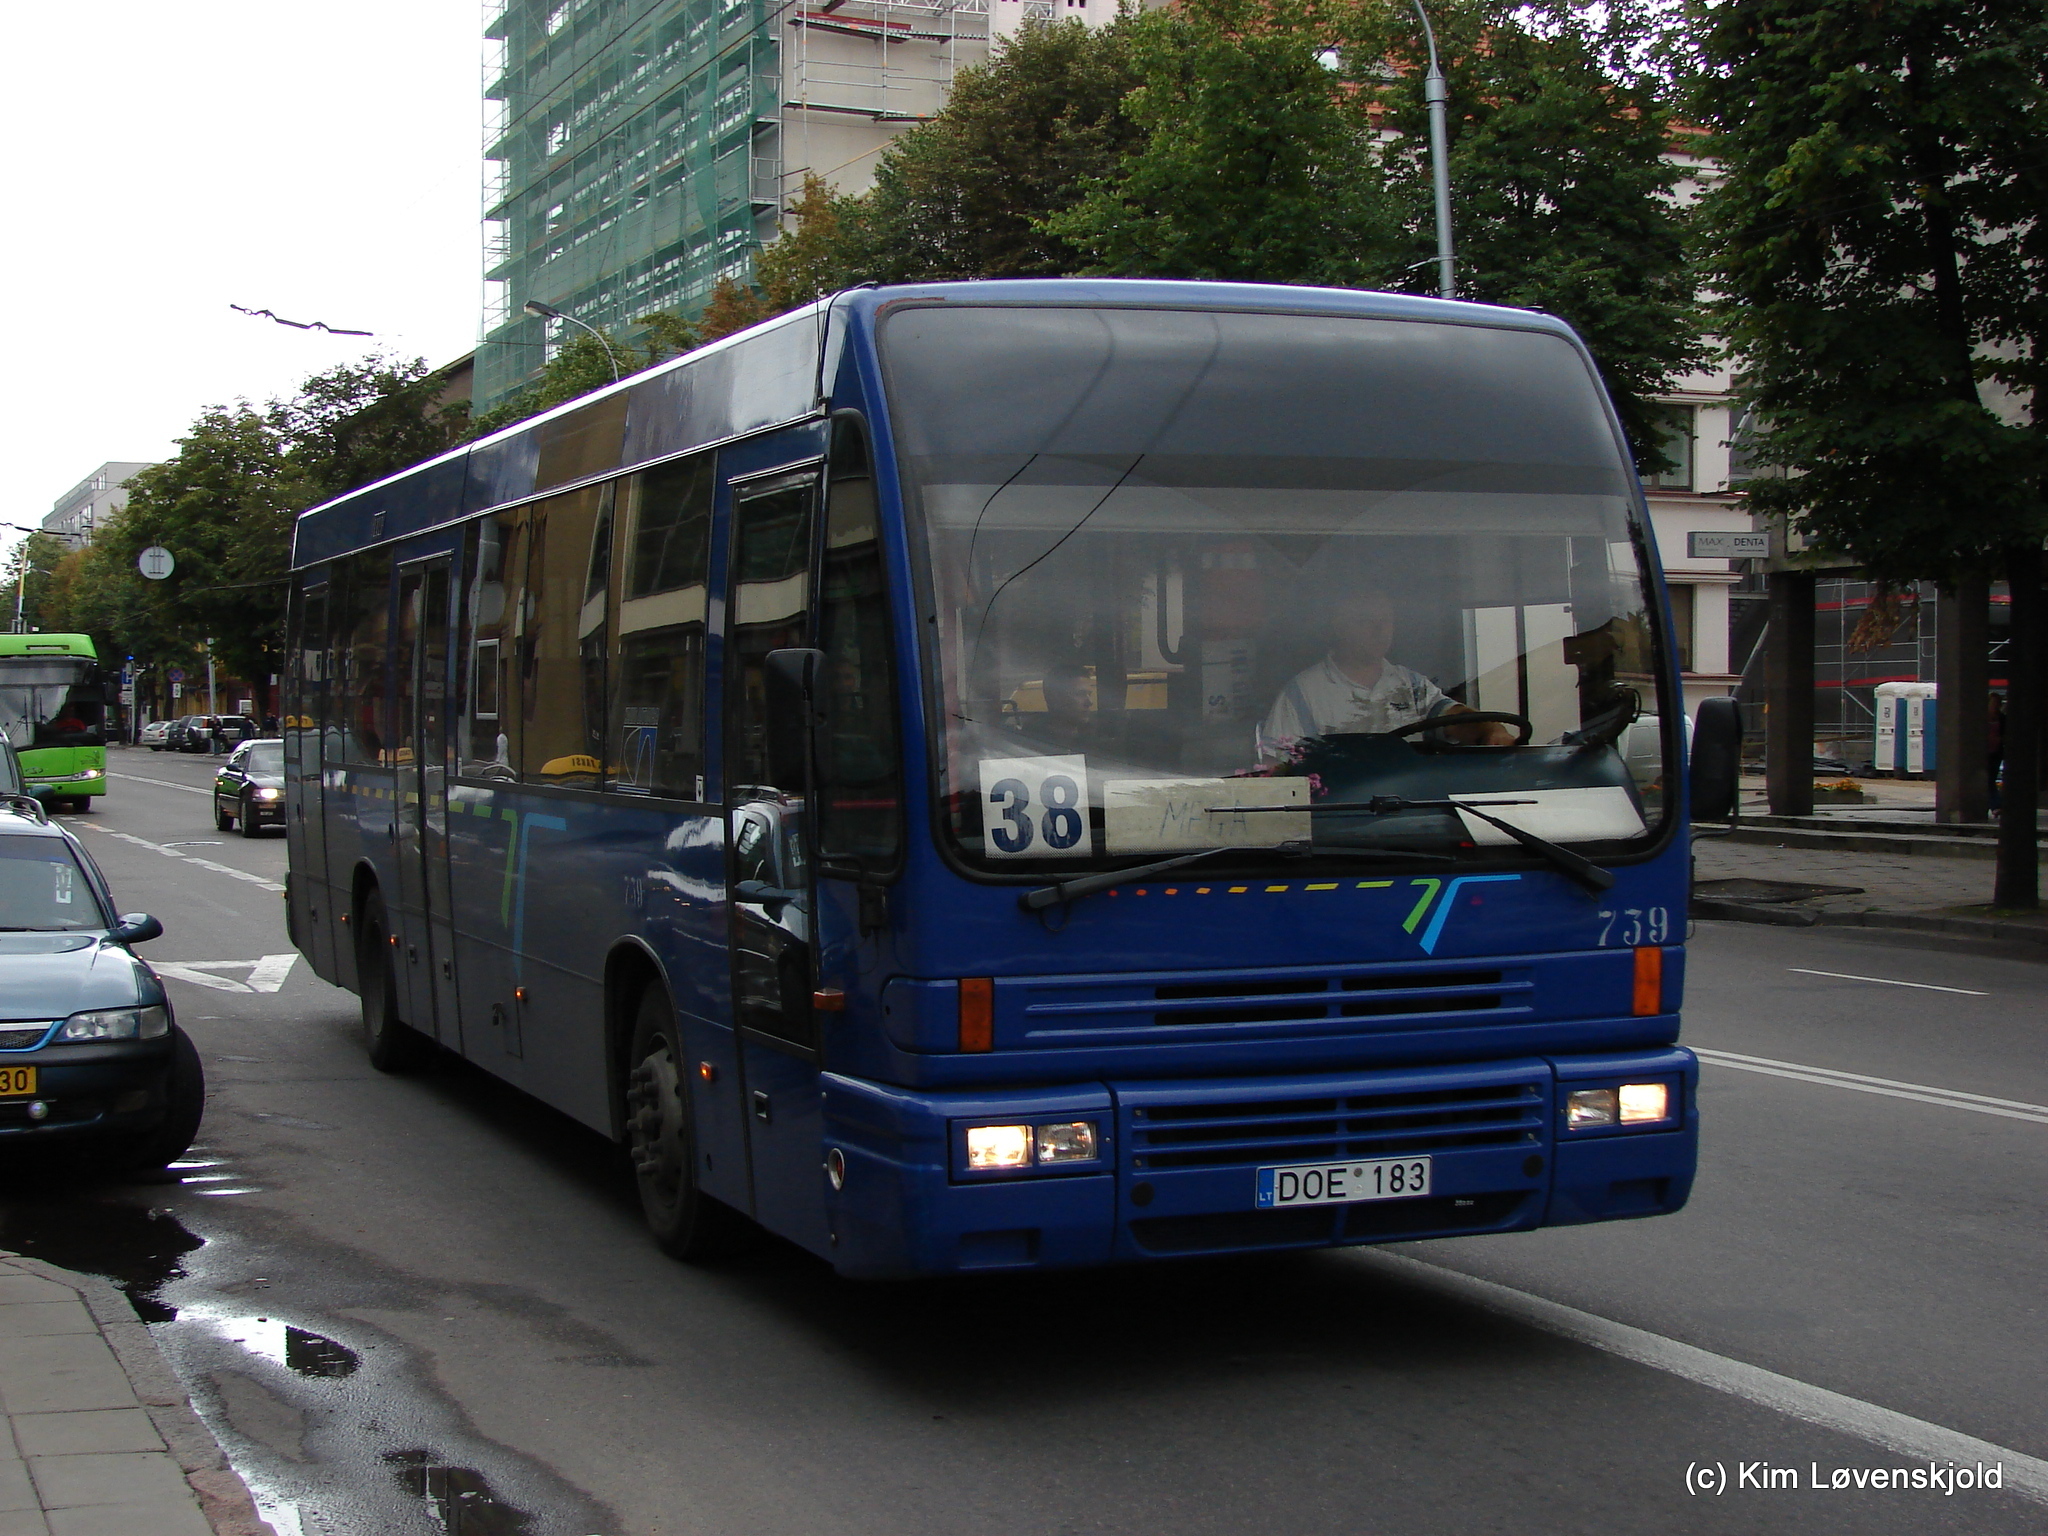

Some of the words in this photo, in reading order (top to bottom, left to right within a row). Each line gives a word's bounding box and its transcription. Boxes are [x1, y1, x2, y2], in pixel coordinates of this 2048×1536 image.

[1698, 537, 1724, 546] MAX
[1733, 537, 1765, 547] DENTA
[989, 774, 1083, 853] 38
[1596, 906, 1668, 947] 739
[1259, 1191, 1273, 1202] LT
[1278, 1167, 1347, 1202] DOE
[1373, 1162, 1425, 1195] 183
